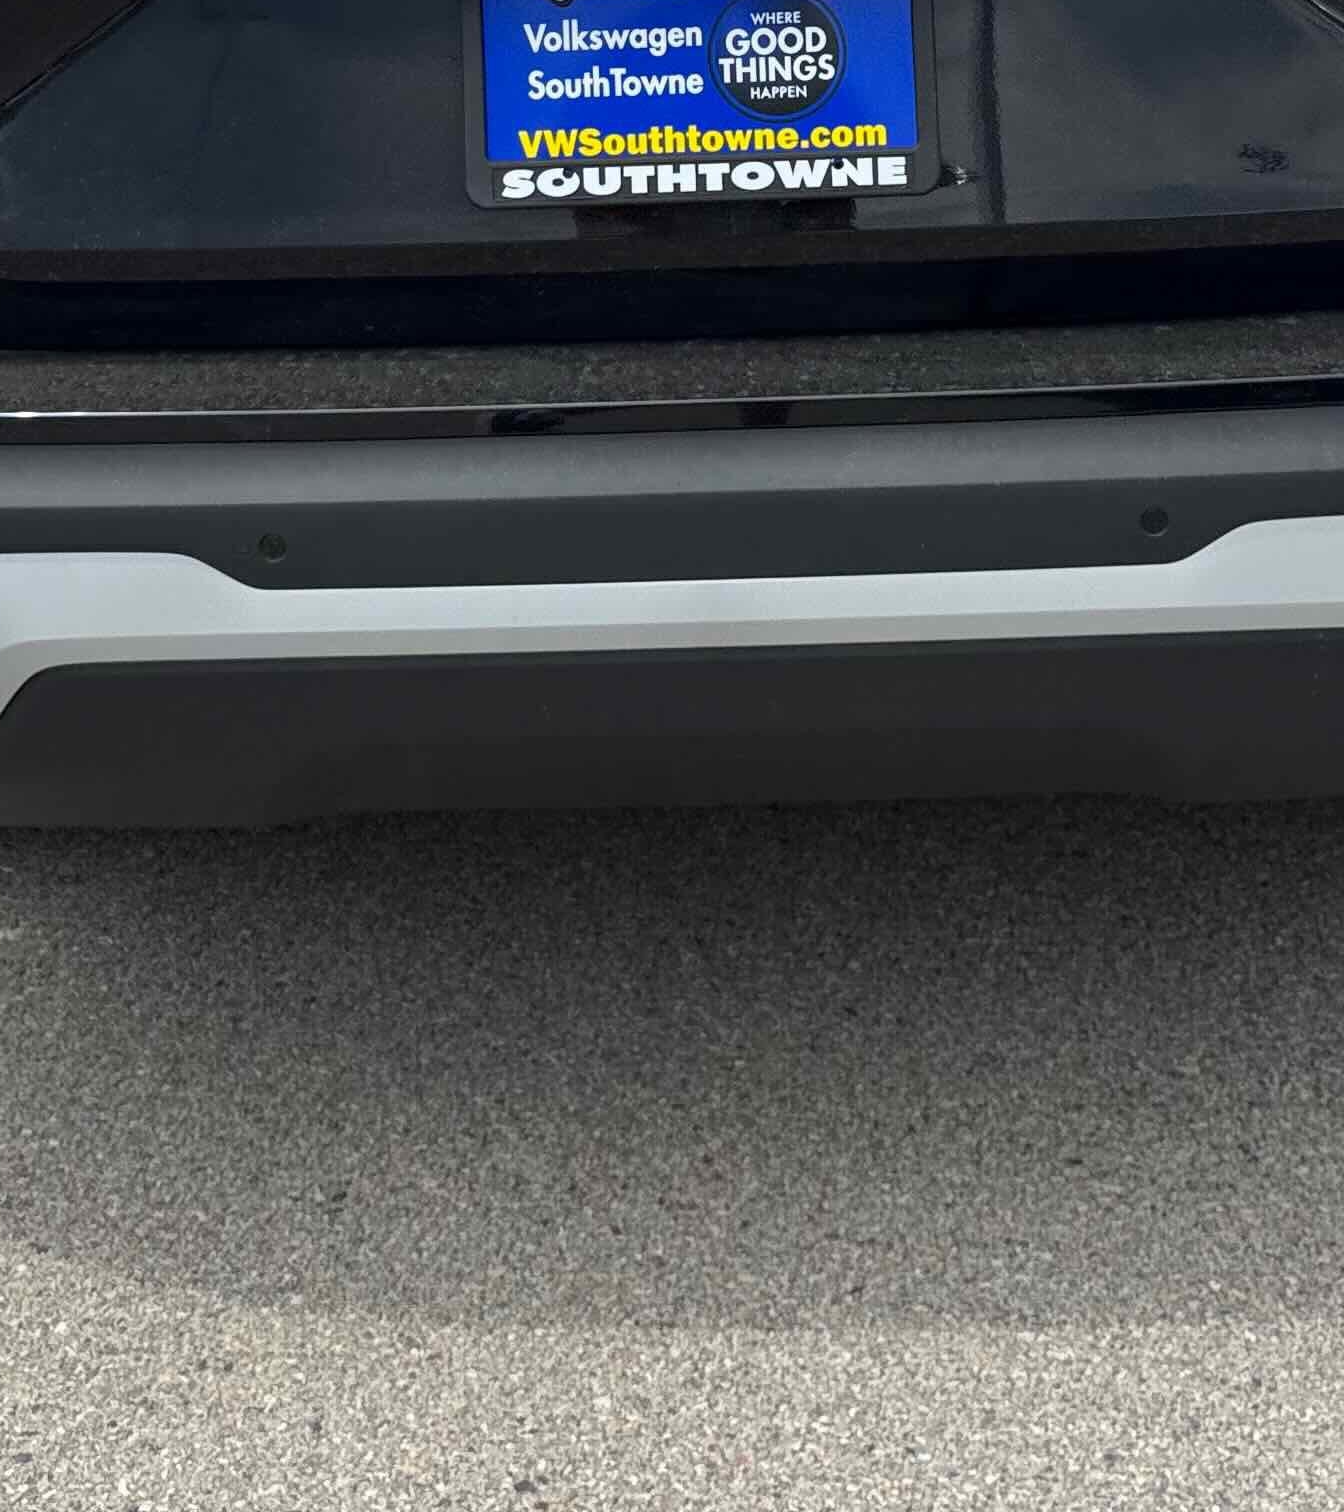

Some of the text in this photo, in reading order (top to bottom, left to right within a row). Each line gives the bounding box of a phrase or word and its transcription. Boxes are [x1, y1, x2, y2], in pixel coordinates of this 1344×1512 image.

[750, 12, 801, 25] WHERE
[523, 20, 703, 56] Volkswagen
[725, 27, 827, 54] GOOD
[528, 66, 704, 100] SouthTowne
[718, 54, 835, 82] THINGS
[749, 85, 807, 99] HAPPEN
[518, 124, 887, 159] VWSouthtowne.com
[501, 157, 907, 199] SOUTHTOWNE
